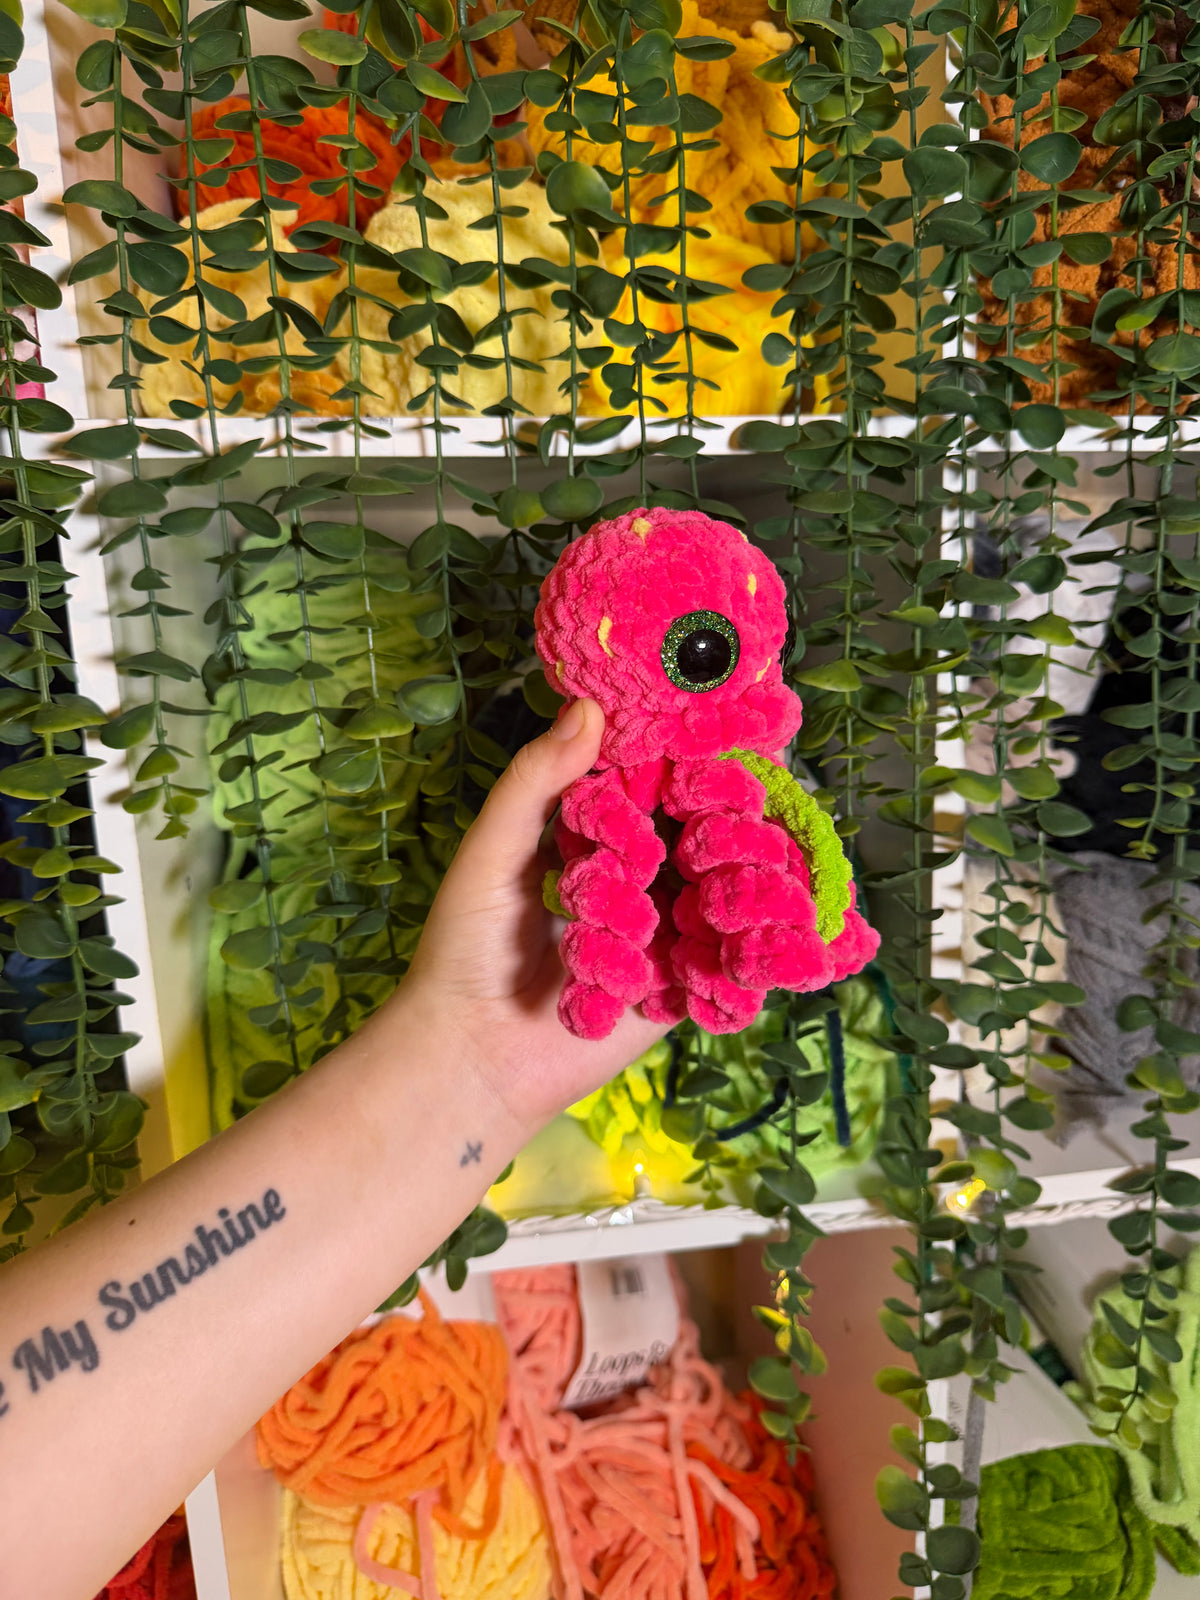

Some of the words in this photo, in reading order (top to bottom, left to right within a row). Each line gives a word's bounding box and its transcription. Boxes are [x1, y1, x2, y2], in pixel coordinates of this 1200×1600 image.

[12, 1320, 101, 1393] My
[98, 1188, 287, 1332] Sunshine
[584, 1350, 646, 1377] Loops
